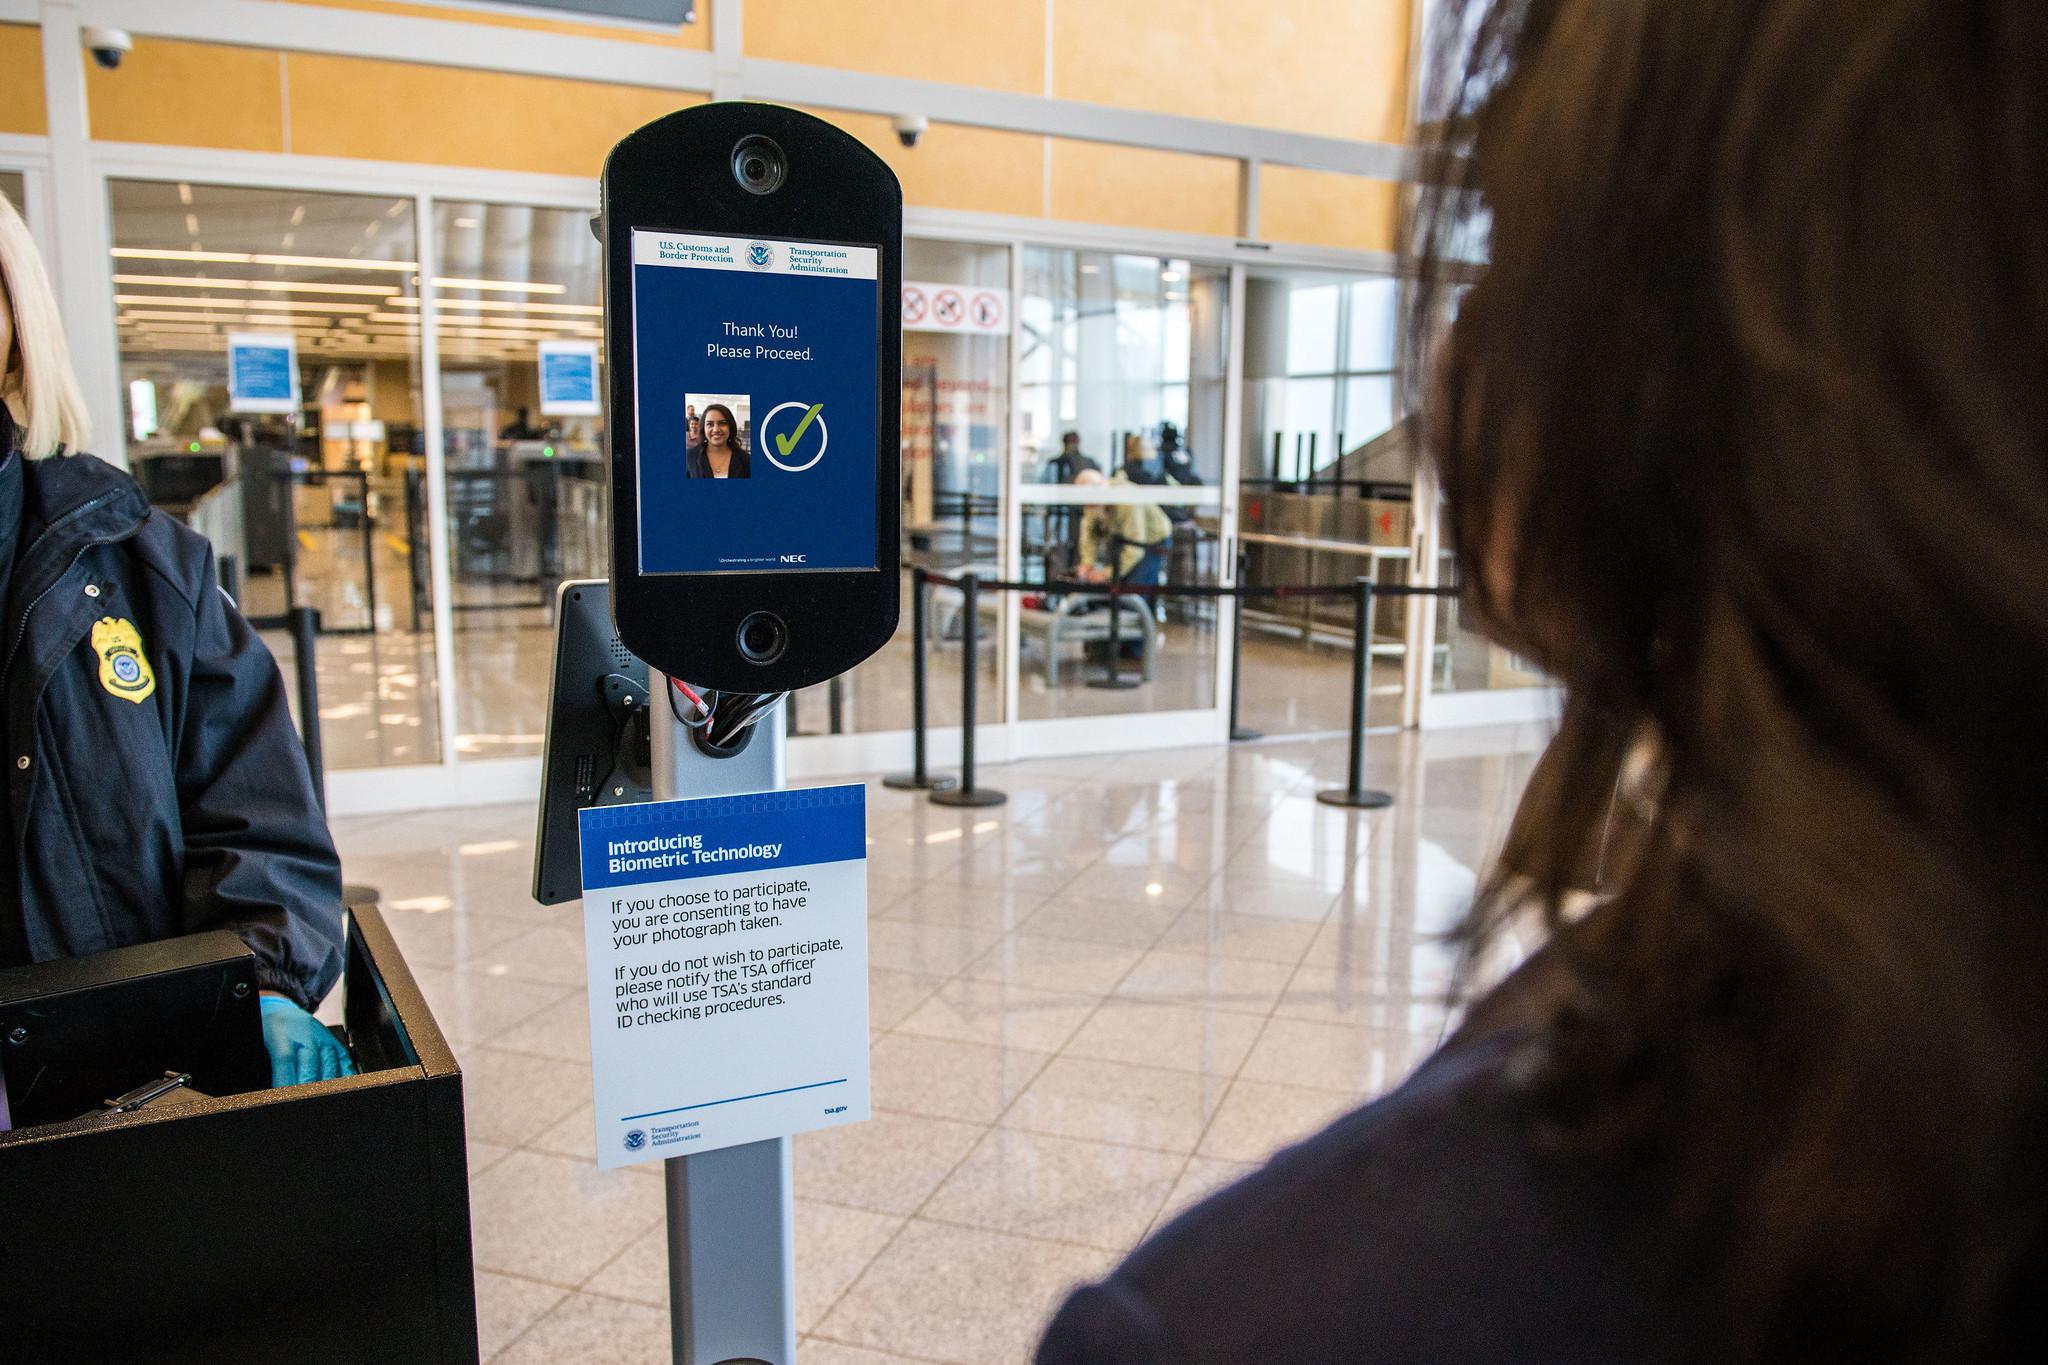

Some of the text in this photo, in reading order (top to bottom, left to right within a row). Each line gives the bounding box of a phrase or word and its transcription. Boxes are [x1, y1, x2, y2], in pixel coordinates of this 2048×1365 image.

[659, 241, 730, 254] U.S. Customs and
[790, 247, 847, 258] Transportation
[659, 251, 734, 263] Border Protection
[790, 256, 823, 265] Security
[790, 264, 848, 274] Administration
[723, 322, 798, 339] Thank You!
[707, 344, 814, 361] Please Proceed.
[780, 555, 806, 563] NEC
[609, 834, 702, 855] Introducing
[609, 843, 782, 873] Biometric Technology
[612, 879, 810, 915] If you choose to participate,
[612, 895, 806, 933] you are consenting to have
[613, 915, 782, 949] your photograph taken.
[615, 938, 843, 980] If you do not wish to participate,
[616, 958, 816, 998] please notify the TSA officer
[617, 972, 811, 1012] who will use TSA's standard
[617, 994, 785, 1029] ID checking procedures.
[824, 1106, 848, 1114] tsa.gov
[650, 1121, 699, 1133] Transportation
[652, 1131, 679, 1140] Security
[652, 1134, 701, 1146] Administration
